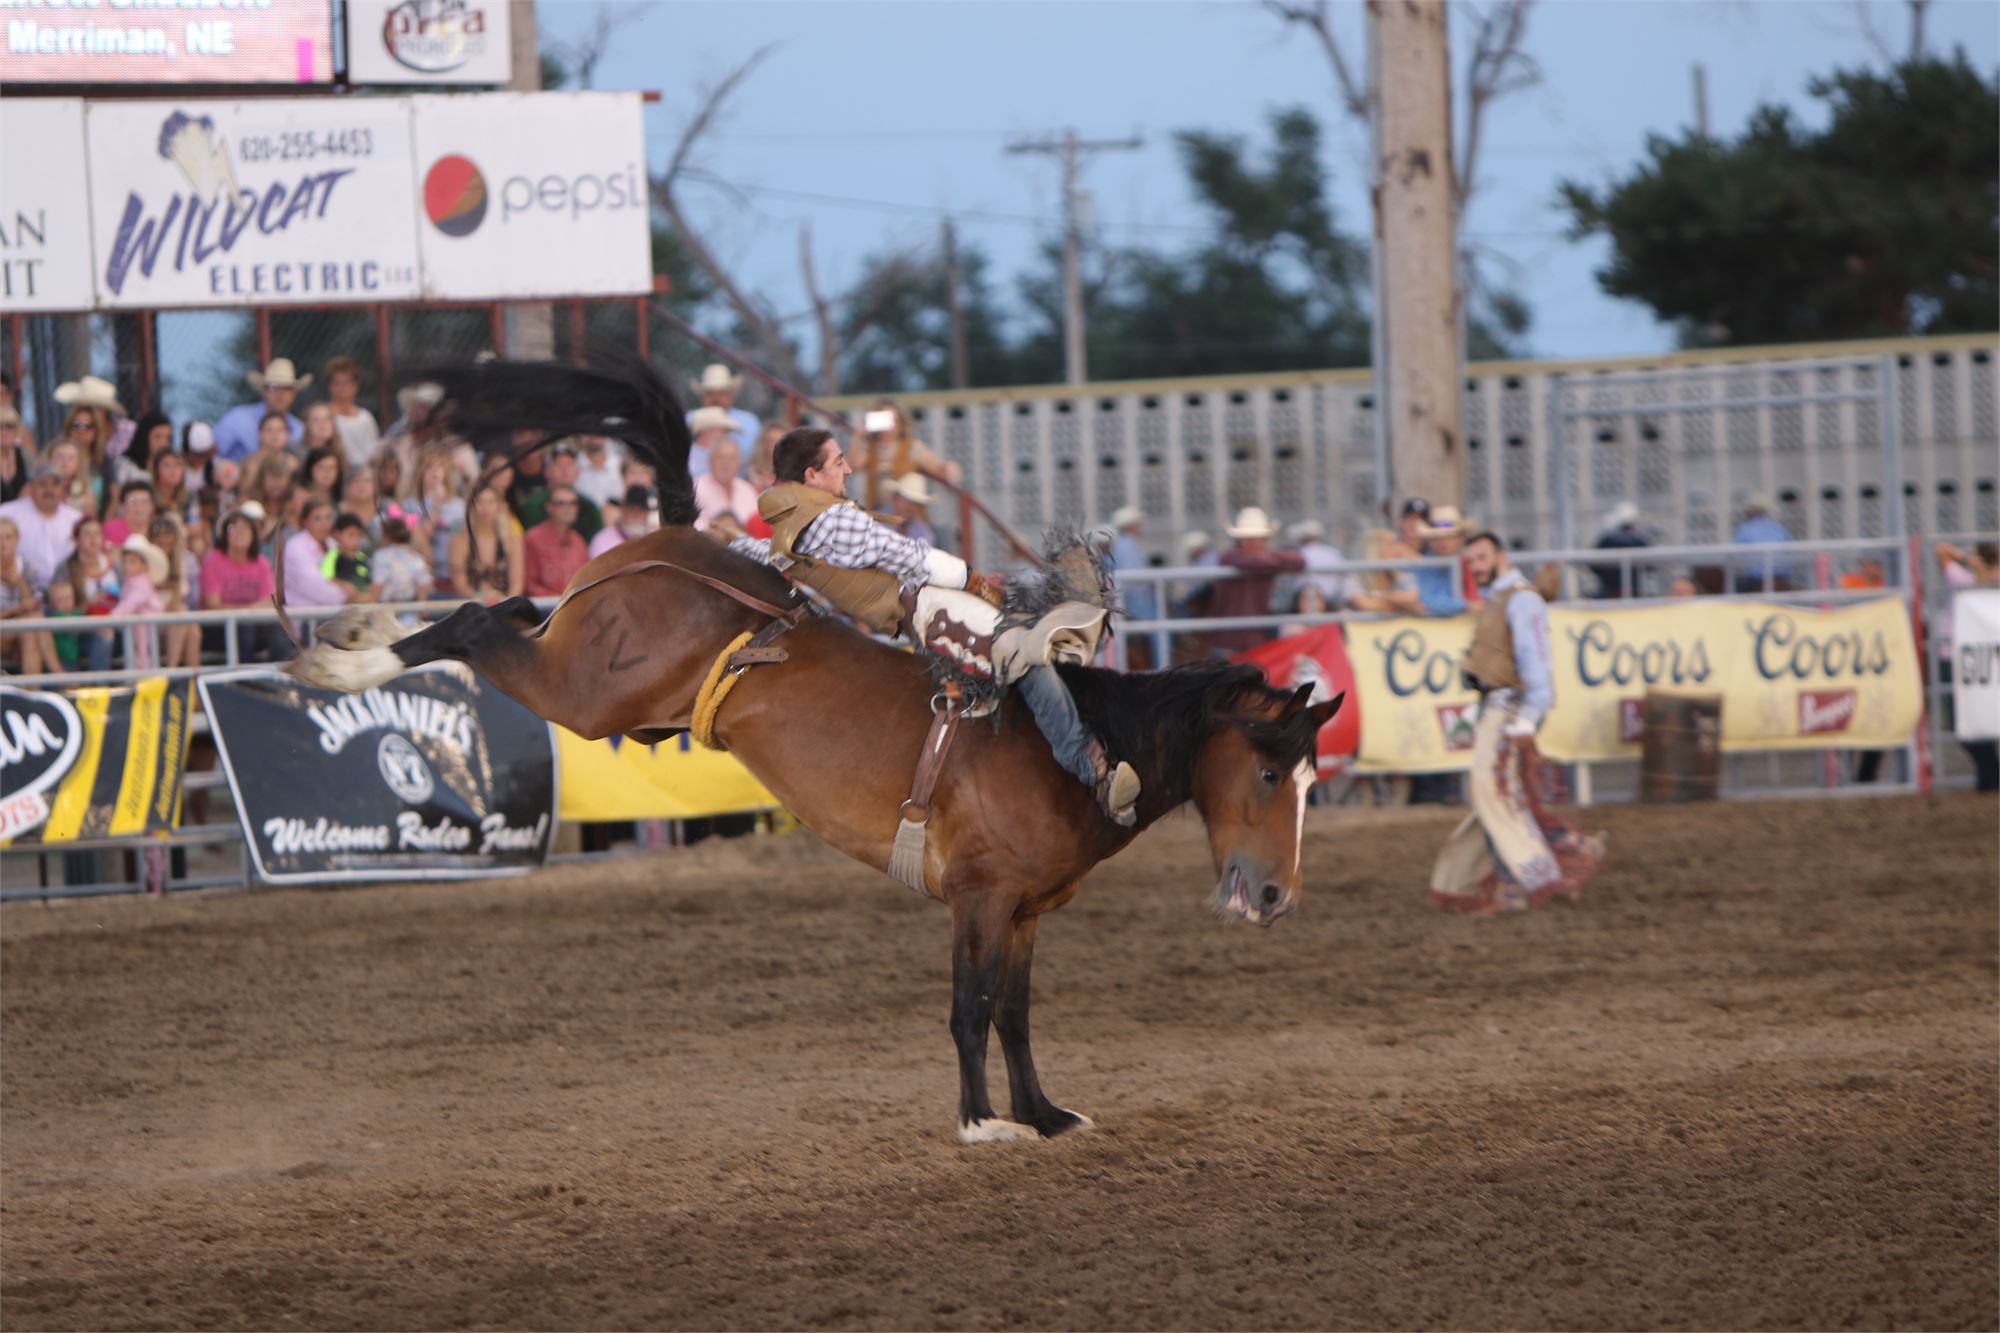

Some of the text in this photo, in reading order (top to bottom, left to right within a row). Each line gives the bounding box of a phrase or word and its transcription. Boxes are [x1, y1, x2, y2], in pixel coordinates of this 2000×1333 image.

[7, 19, 235, 62] Merriman, NE
[238, 128, 374, 163] 620-255-4453
[501, 161, 641, 224] pepsi
[106, 167, 357, 297] WILDCAT
[210, 261, 379, 295] ELECTRIC
[1373, 628, 1466, 697] Co
[1566, 618, 1712, 688] Coors
[1744, 614, 1891, 681] Coors
[263, 811, 549, 856] Welcome Rodeo Fans!
